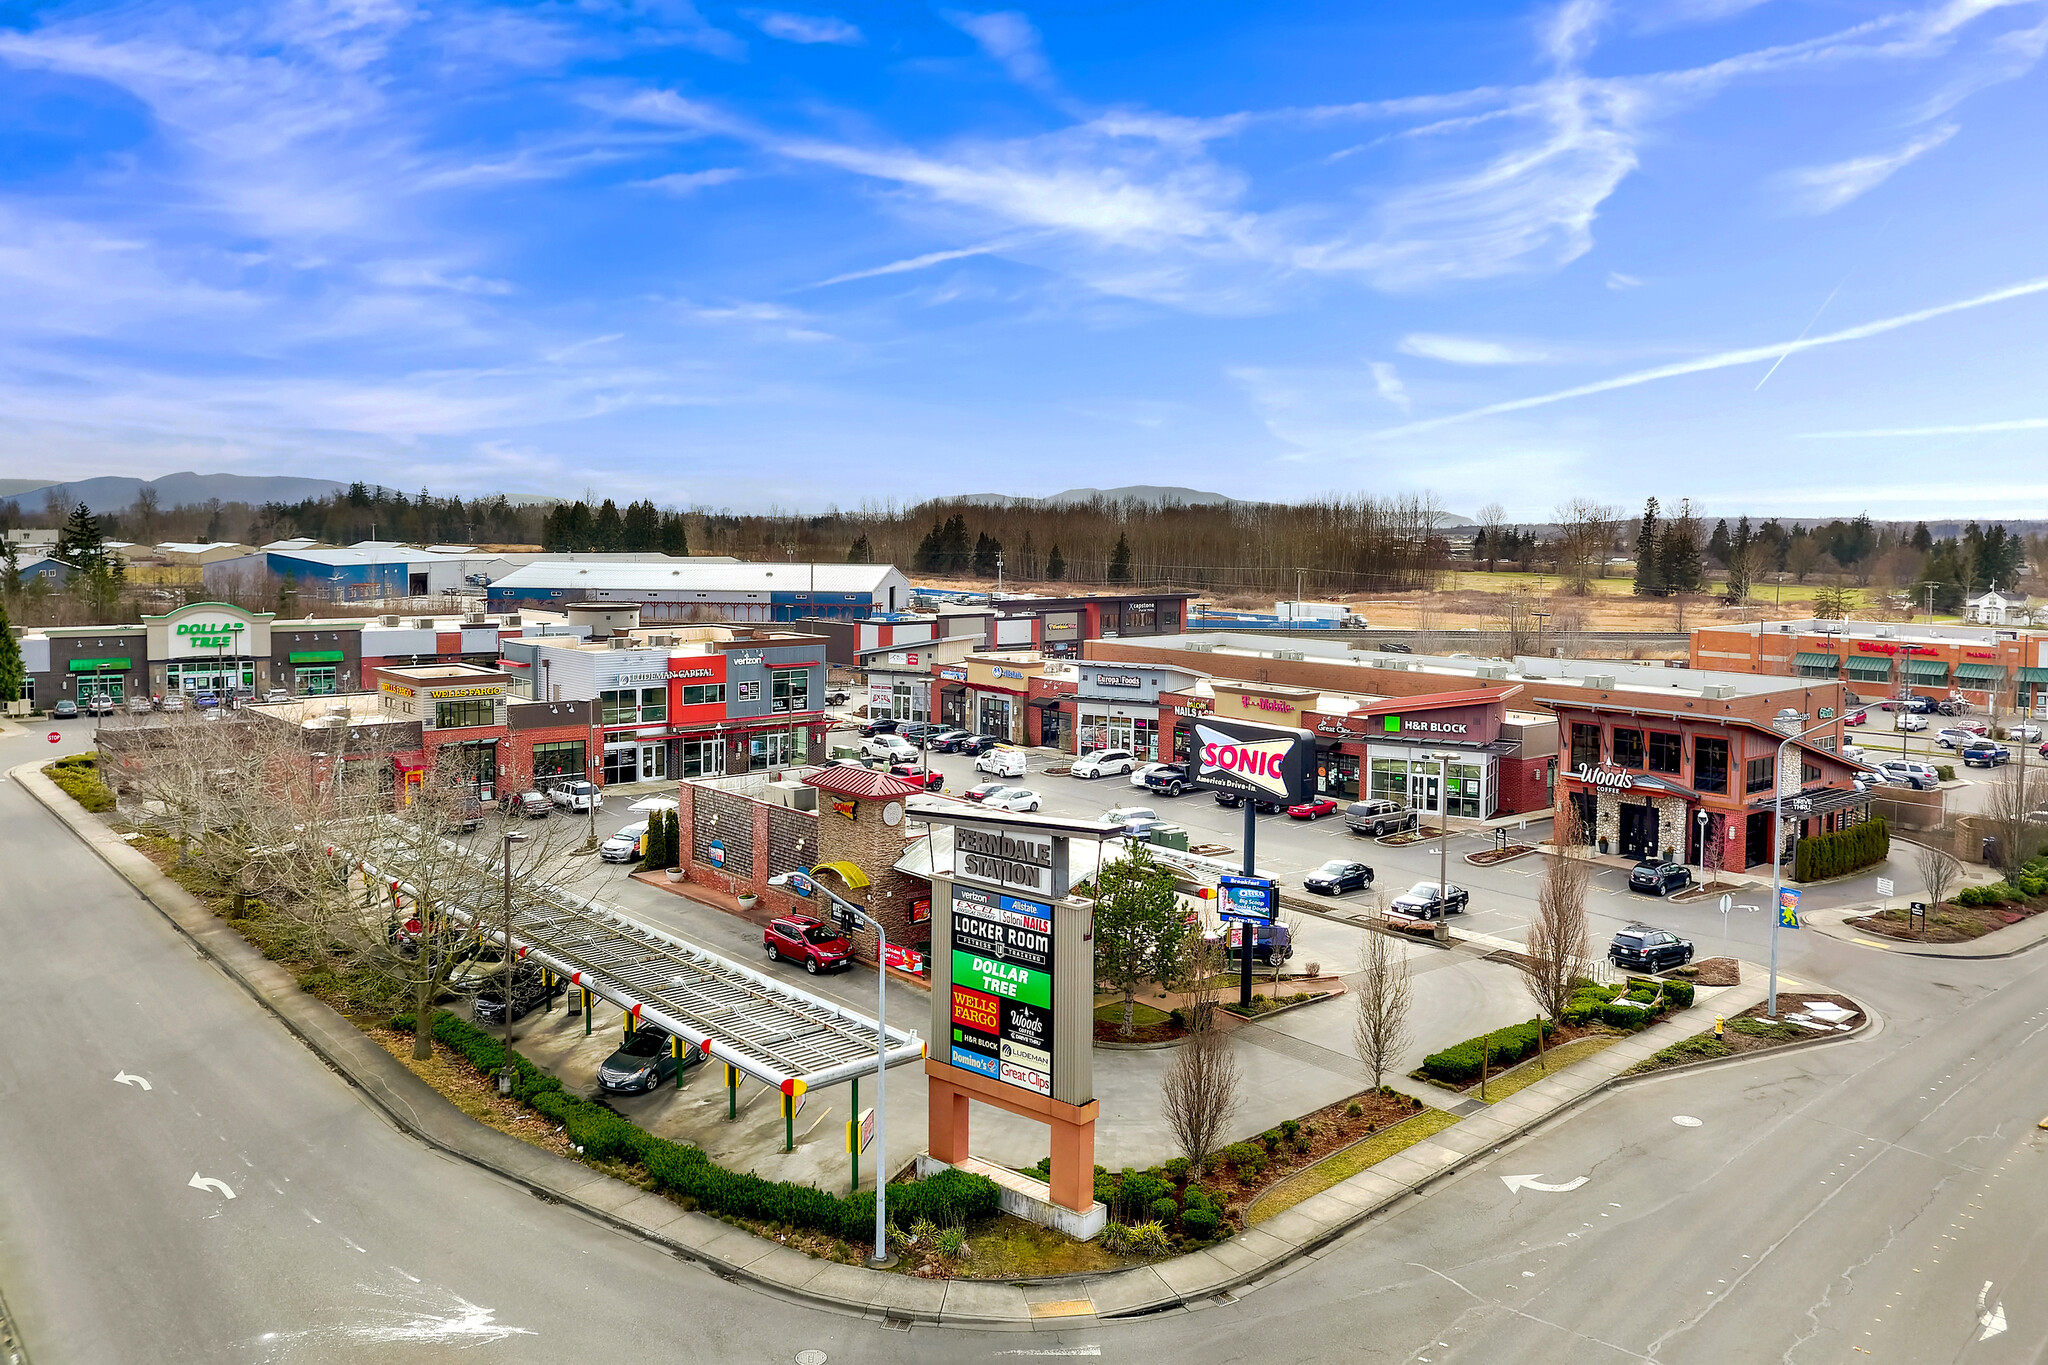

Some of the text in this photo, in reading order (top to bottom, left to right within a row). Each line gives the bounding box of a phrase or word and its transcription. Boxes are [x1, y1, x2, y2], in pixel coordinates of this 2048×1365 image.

[176, 622, 244, 636] DOLLAR
[190, 636, 231, 648] TREE
[733, 656, 762, 666] verizon
[1097, 674, 1120, 685] Europa
[1121, 676, 1140, 685] Foods
[431, 686, 501, 699] WELLS FARGO
[1174, 705, 1197, 718] NAILS
[1317, 723, 1336, 733] Great
[1404, 720, 1467, 734] H&R BLOCK
[47, 733, 61, 742] STOP
[1203, 742, 1284, 780] SONIC
[1196, 775, 1226, 788] America's
[1578, 762, 1633, 789] Woods
[1596, 785, 1620, 795] COFFEE
[833, 802, 853, 815] SONIC
[1793, 798, 1812, 806] DRIVE
[956, 828, 1051, 865] FERNDALE
[964, 854, 1040, 888] STATION
[1230, 877, 1260, 886] Breakfast
[961, 890, 988, 903] verizon
[1249, 899, 1265, 907] Scoop
[957, 900, 996, 915] EXCEL
[1011, 900, 1038, 914] Allstate
[1252, 905, 1270, 913] Dough
[1023, 916, 1049, 933] NAILS
[955, 915, 1049, 953] LOCKER ROOM
[963, 937, 992, 949] FITNESS
[1008, 949, 1041, 962] TRAINING
[972, 957, 1029, 984] DOLLAR
[982, 976, 1018, 997] TREE
[953, 991, 997, 1014] WELLS
[954, 1005, 997, 1028] FARGO
[1010, 1010, 1043, 1032] Woods
[1018, 1027, 1035, 1036] COFFEE
[964, 1034, 999, 1051] H&R BLOCK
[1015, 1034, 1029, 1043] DRIVE
[952, 1050, 987, 1071] Domino's
[1012, 1048, 1049, 1065] LUDEMAN
[1001, 1062, 1050, 1092] Great Clips
